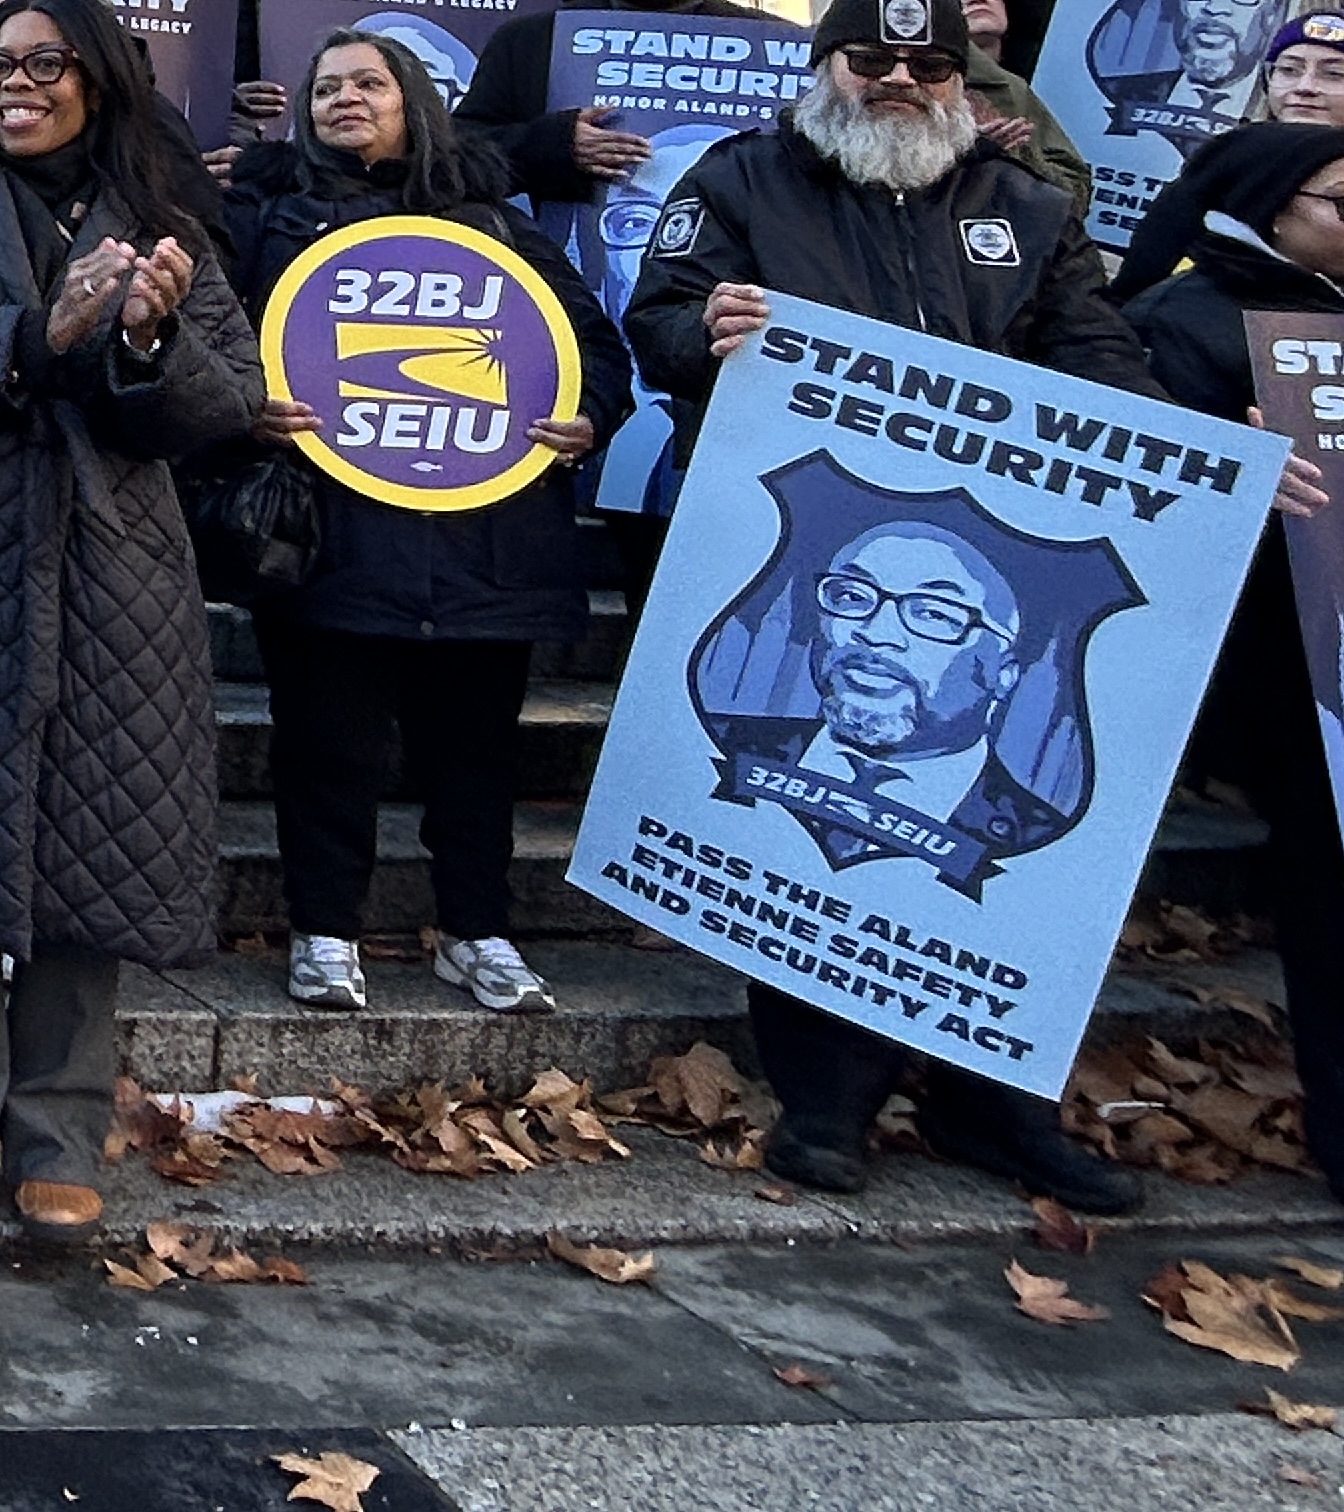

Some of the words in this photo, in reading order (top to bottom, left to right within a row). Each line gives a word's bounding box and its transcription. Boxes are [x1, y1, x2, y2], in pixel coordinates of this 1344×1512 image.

[131, 16, 192, 34] LEGACY
[572, 28, 752, 62] STAND
[596, 60, 817, 100] SECURI
[593, 94, 667, 111] HONOR
[674, 99, 772, 120] ALAND'S
[1093, 166, 1137, 186] SS
[328, 268, 504, 320] 32BJ
[336, 402, 510, 454] SEIU
[760, 325, 1012, 423] STAND
[1035, 403, 1242, 495] WITH
[788, 382, 1181, 522] SECURITY
[745, 765, 827, 806] 32BJ
[874, 811, 956, 857] SEIU
[638, 815, 753, 880] PASS
[763, 870, 852, 924] THE
[858, 913, 1029, 991] ALAND
[631, 843, 820, 944] ETIENNE
[827, 932, 1018, 1020] SAFETY
[600, 861, 692, 916] AND
[699, 908, 929, 1021] SECURITY
[936, 1012, 1035, 1062] ACT
